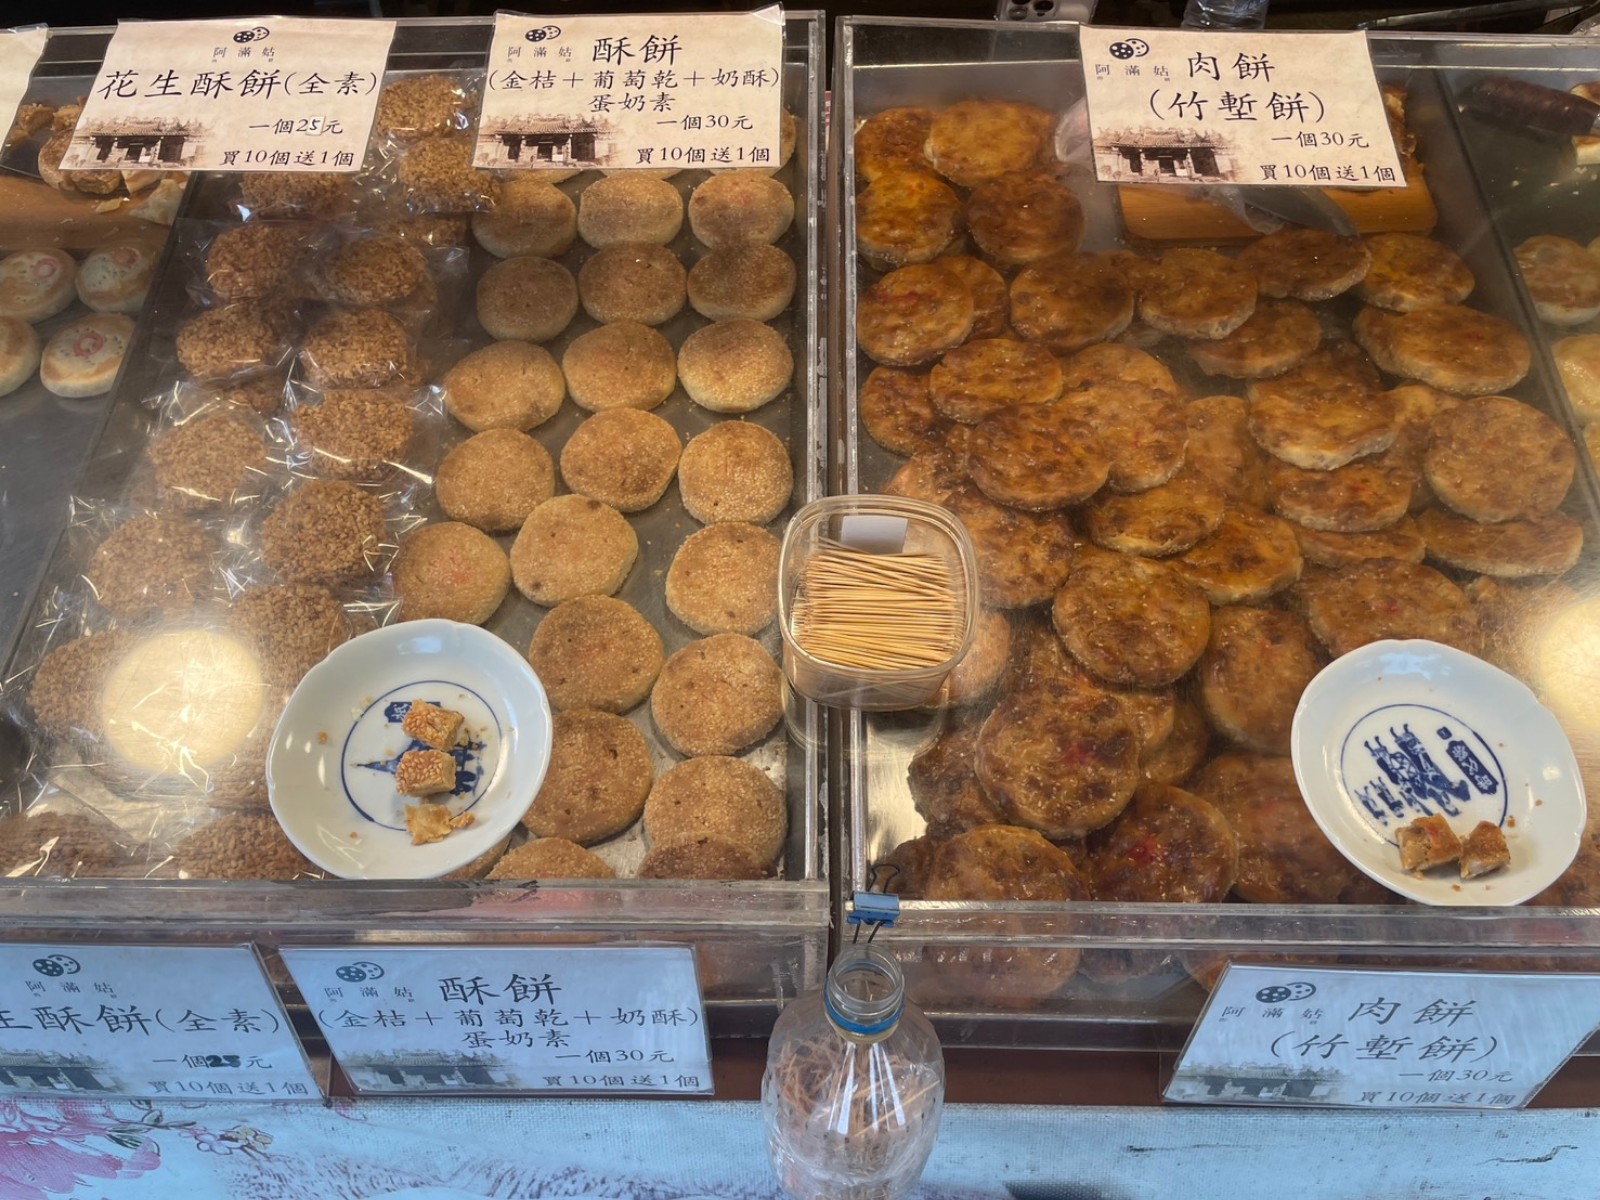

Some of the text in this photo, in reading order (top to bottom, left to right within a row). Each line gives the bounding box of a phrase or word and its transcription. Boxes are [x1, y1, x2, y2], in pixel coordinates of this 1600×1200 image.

[213, 47, 275, 58] 阿滿姑
[508, 46, 572, 58] 阿滿姑
[592, 35, 682, 65] 酥餅
[1095, 64, 1168, 77] 阿滿姑
[1187, 52, 1275, 82] 肉餅
[97, 68, 378, 100] 花生酥餅(全素)
[489, 67, 779, 91] (金桔+葡萄乾+奶酥)
[589, 92, 675, 112] 蛋奶素
[1150, 89, 1324, 123] (竹塹餅)
[249, 117, 343, 136] 一個25元
[656, 115, 753, 130] 一個30元
[1271, 131, 1369, 148] 一個30元
[220, 150, 354, 166] 買10個送1個
[636, 147, 769, 164] 買10個送1個
[1259, 165, 1395, 182] 買10個送1個
[25, 980, 114, 993] 阿滿姑
[324, 987, 413, 999] 阿滿姑
[438, 974, 561, 1006] 酥餅
[318, 1007, 698, 1028] (金桔+葡萄乾+奶酥)
[1348, 997, 1476, 1027] 肉餅
[462, 1030, 570, 1048] 蛋奶素
[1271, 1031, 1497, 1063] (竹塹餅)
[555, 1048, 674, 1064] 一個30元
[542, 1074, 700, 1088] 買10個送1個
[1398, 1069, 1513, 1083] 一個30元
[148, 1080, 308, 1095] 買10個送1個
[1360, 1091, 1515, 1106] 買10個送1個
